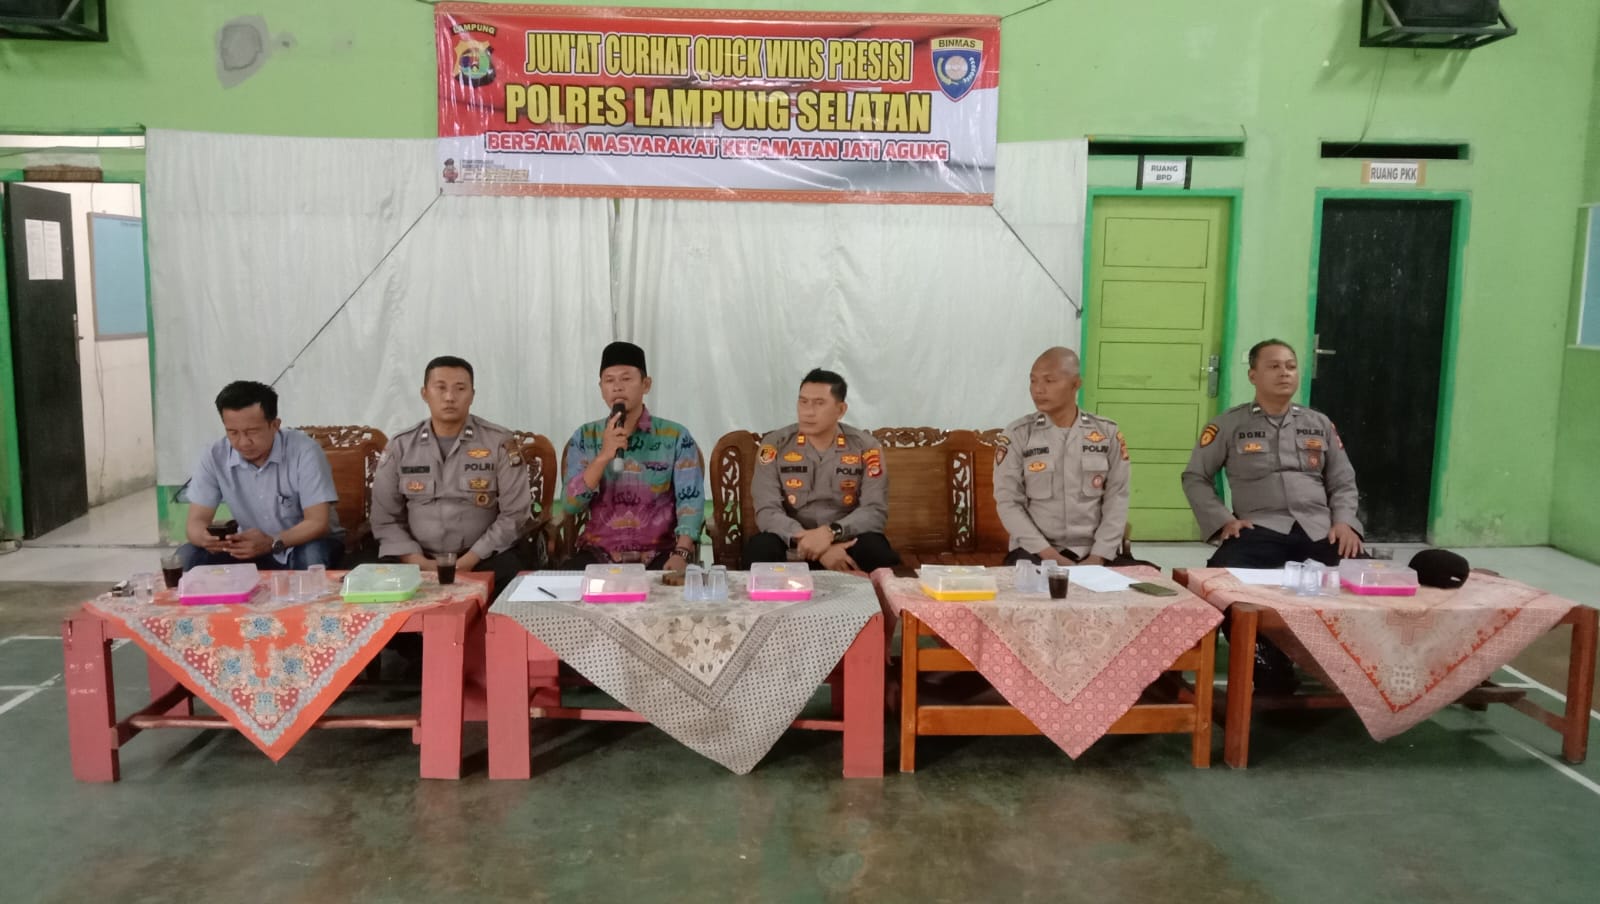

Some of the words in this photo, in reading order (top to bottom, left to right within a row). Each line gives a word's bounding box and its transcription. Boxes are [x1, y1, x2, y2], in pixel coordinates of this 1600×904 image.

[453, 23, 496, 34] LAMPUNG
[938, 39, 976, 48] BINMAS
[526, 32, 602, 74] JUM'AT
[604, 33, 691, 76] CURHAT
[694, 36, 763, 81] QUICK
[764, 38, 825, 80] WINS
[827, 39, 913, 82] PRESISI
[505, 84, 627, 126] POLRES
[634, 87, 791, 130] LAMPUNG
[796, 91, 932, 133] SELATAN
[486, 132, 581, 154] BERSAMA
[586, 134, 718, 157] MASYARAKAT
[720, 138, 839, 160] KECAMATAN
[841, 140, 880, 160] JATI
[884, 141, 950, 162] AGUNG
[1151, 164, 1178, 172] RUANG
[1370, 167, 1399, 180] RUANG
[1400, 167, 1417, 180] PKK
[464, 463, 495, 472] POLRI
